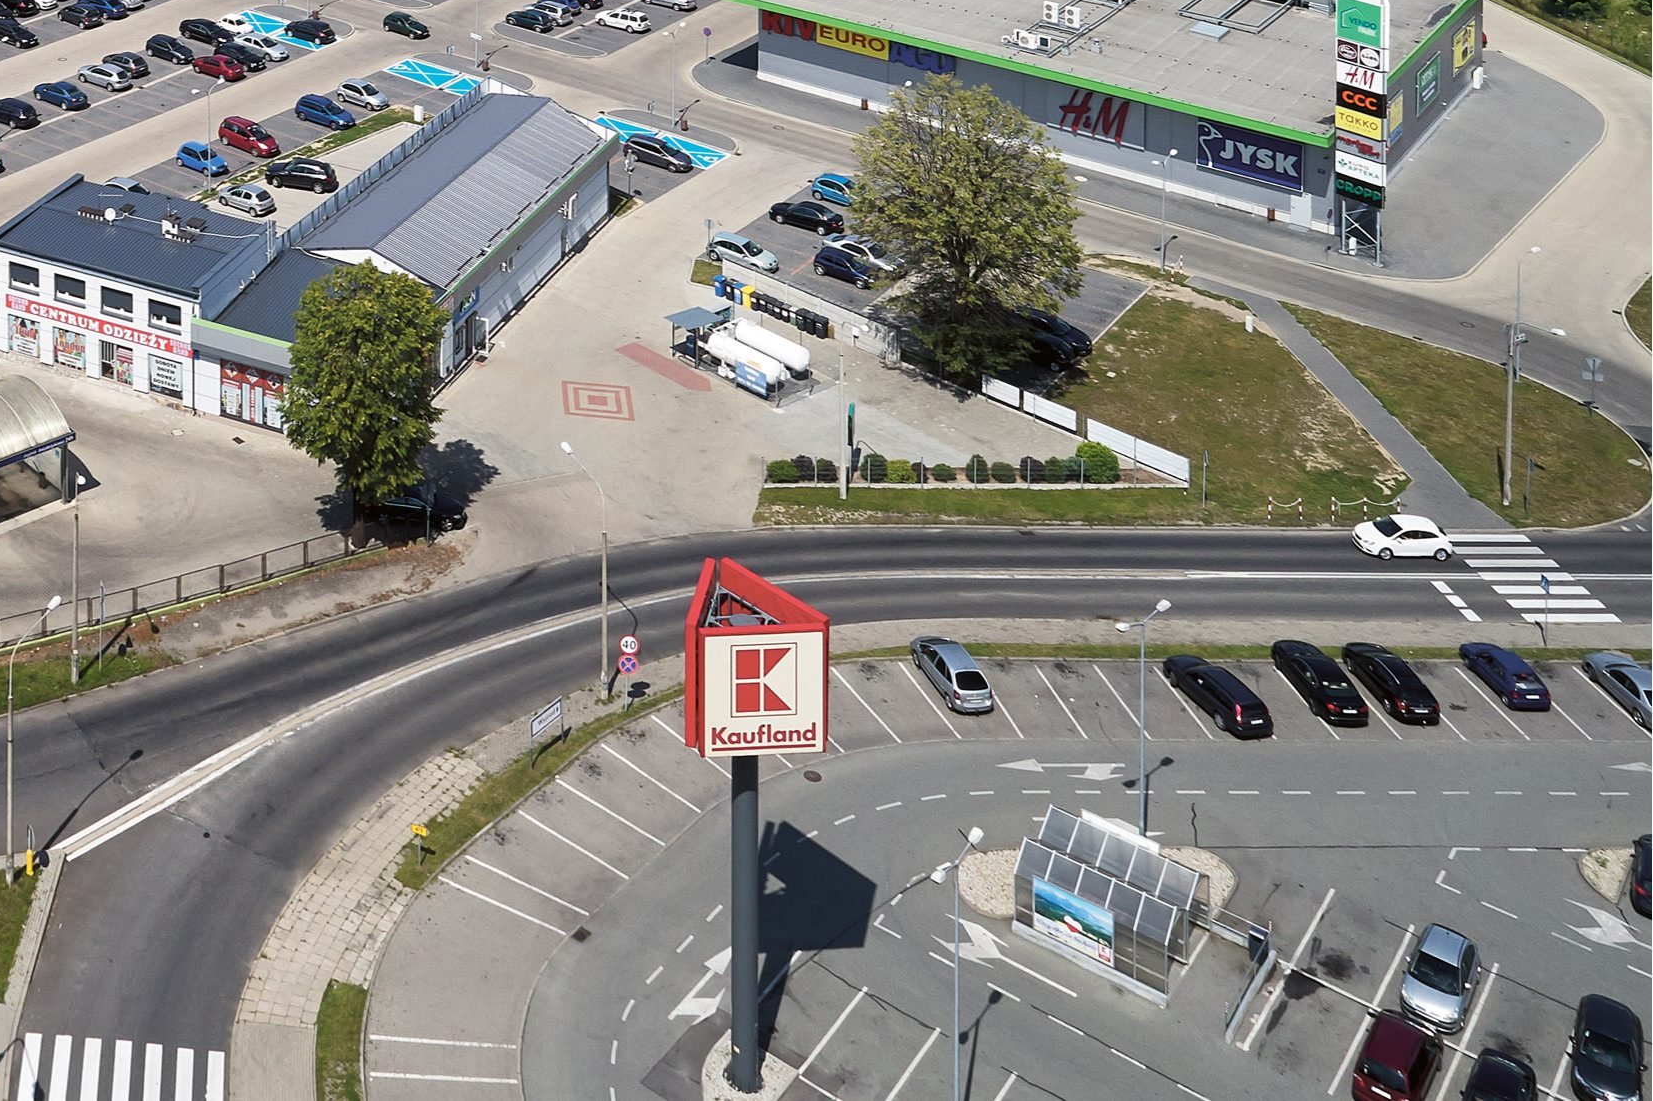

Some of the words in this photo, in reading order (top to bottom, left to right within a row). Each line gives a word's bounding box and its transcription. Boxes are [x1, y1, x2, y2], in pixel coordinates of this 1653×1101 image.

[1348, 16, 1377, 31] VENDO
[819, 26, 886, 53] EURO
[1344, 65, 1375, 90] H&M
[1341, 90, 1378, 111] CCC
[1059, 89, 1131, 147] H&M
[1219, 139, 1300, 178] JYSK
[1347, 165, 1380, 180] APTEKA
[1335, 178, 1382, 202] CROPP
[30, 303, 99, 333] CENTRUM
[103, 323, 169, 351] ODZIEŻY
[155, 358, 178, 369] SOBOTA
[157, 366, 176, 375] DNIEM
[153, 377, 179, 389] DOSTAWY
[156, 372, 177, 382] NOWEJ
[622, 640, 637, 650] 40
[711, 721, 817, 747] Kaufland
